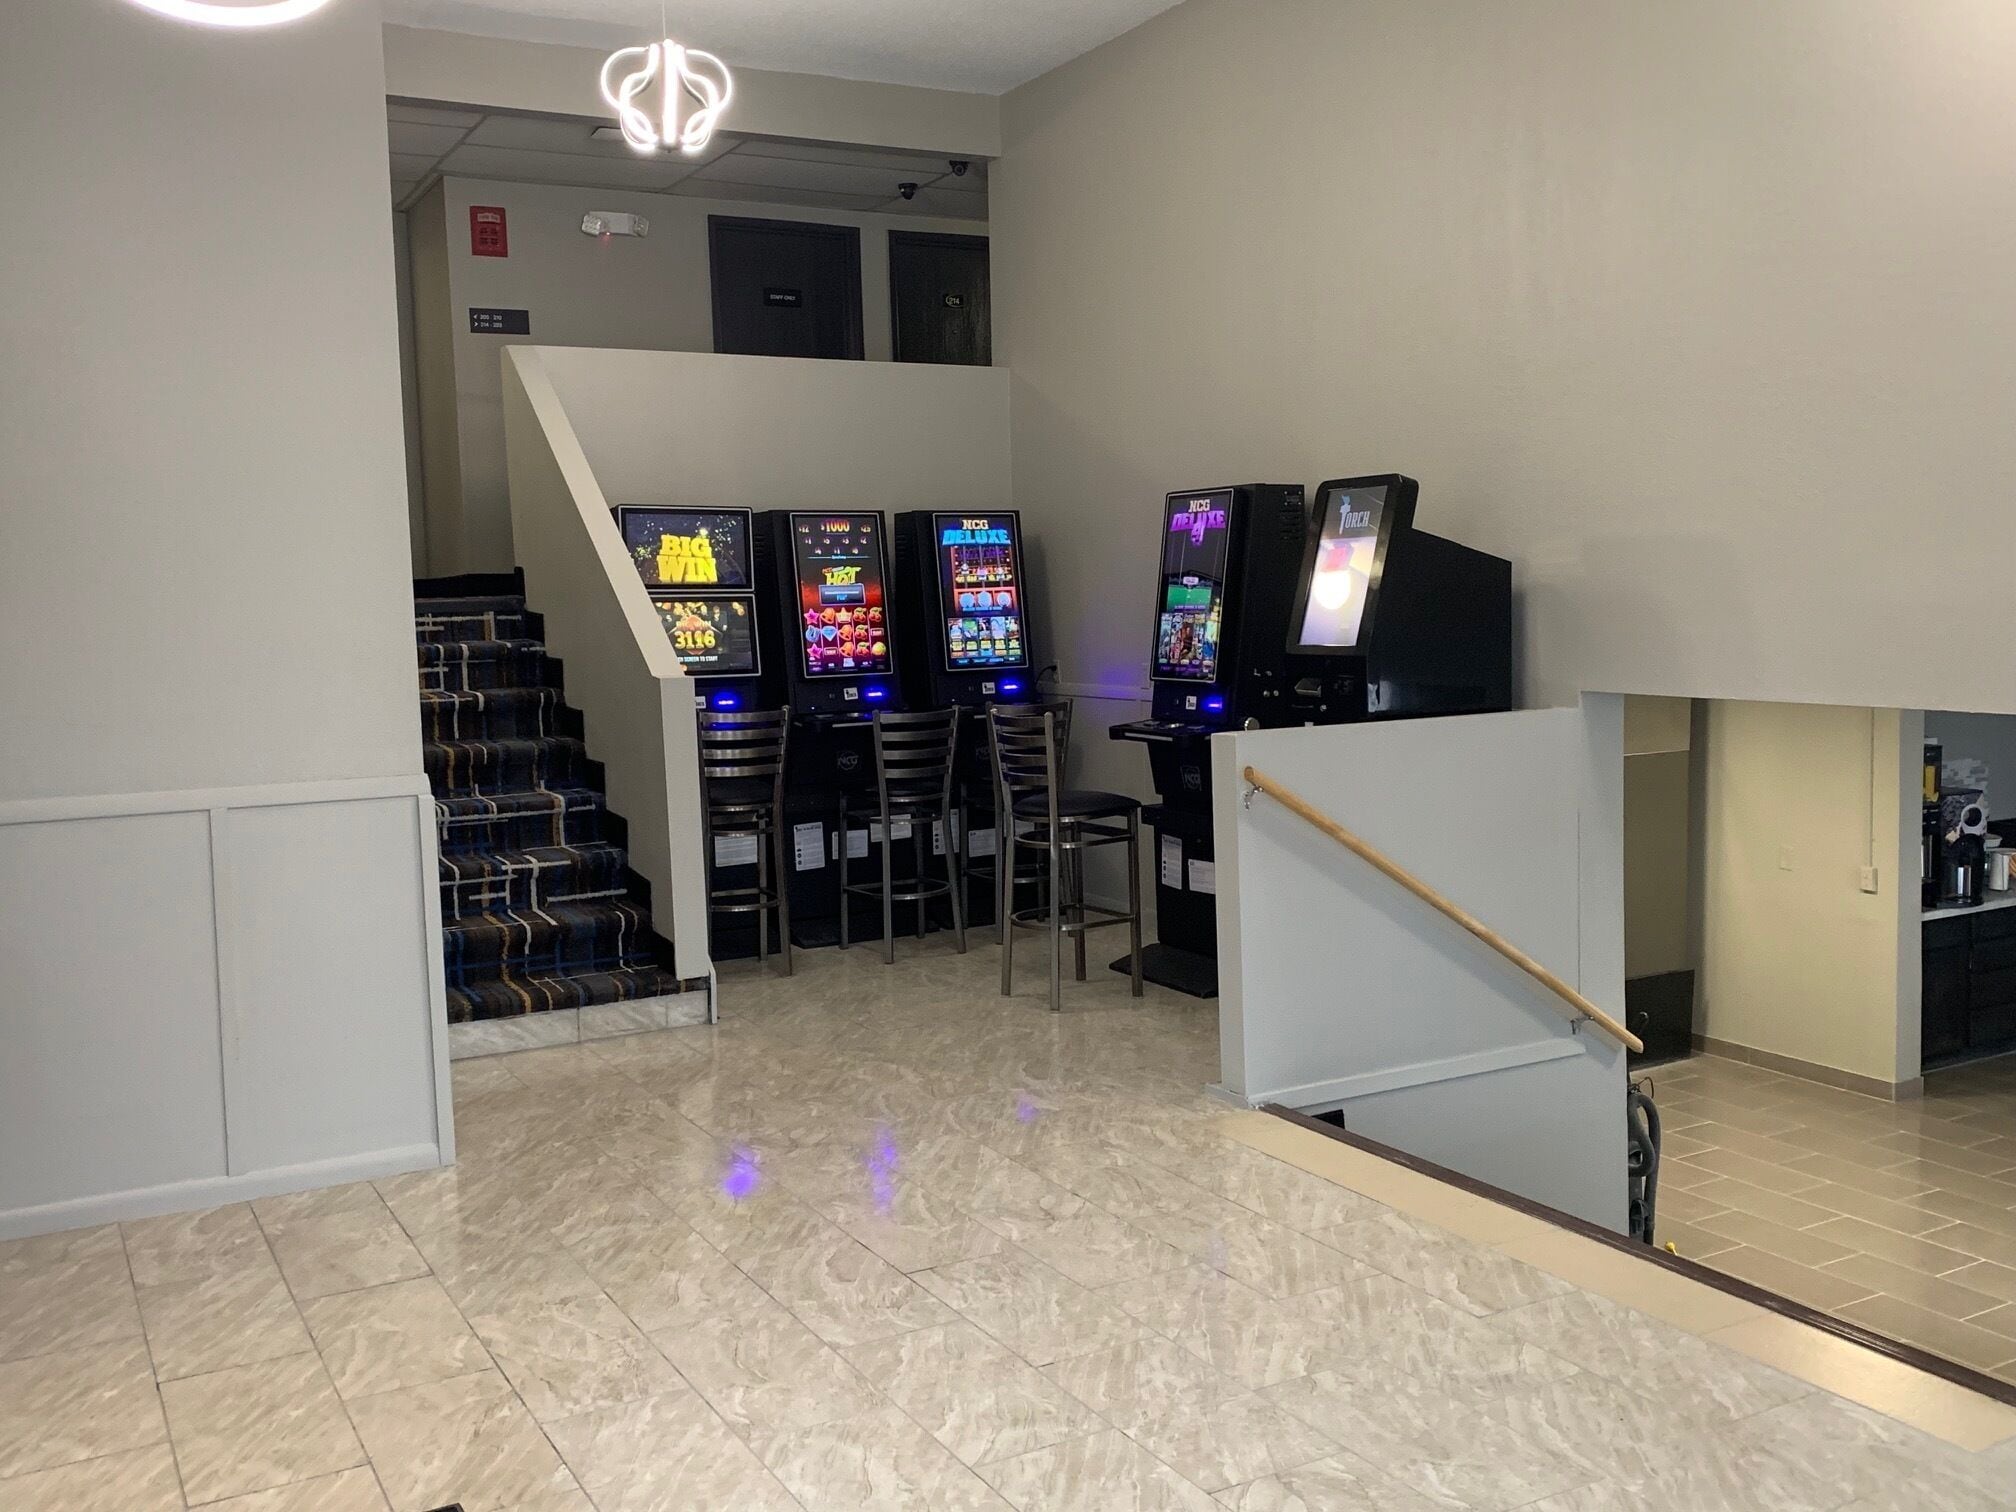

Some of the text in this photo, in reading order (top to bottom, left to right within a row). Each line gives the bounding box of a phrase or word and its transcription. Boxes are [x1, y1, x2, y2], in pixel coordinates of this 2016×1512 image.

[1188, 499, 1211, 513] NCG
[962, 519, 990, 530] NCG
[1170, 510, 1227, 532] DELUXE
[659, 534, 713, 558] BIG
[942, 529, 1012, 546] DELUXE
[656, 554, 719, 583] WIN
[824, 566, 861, 586] HOT
